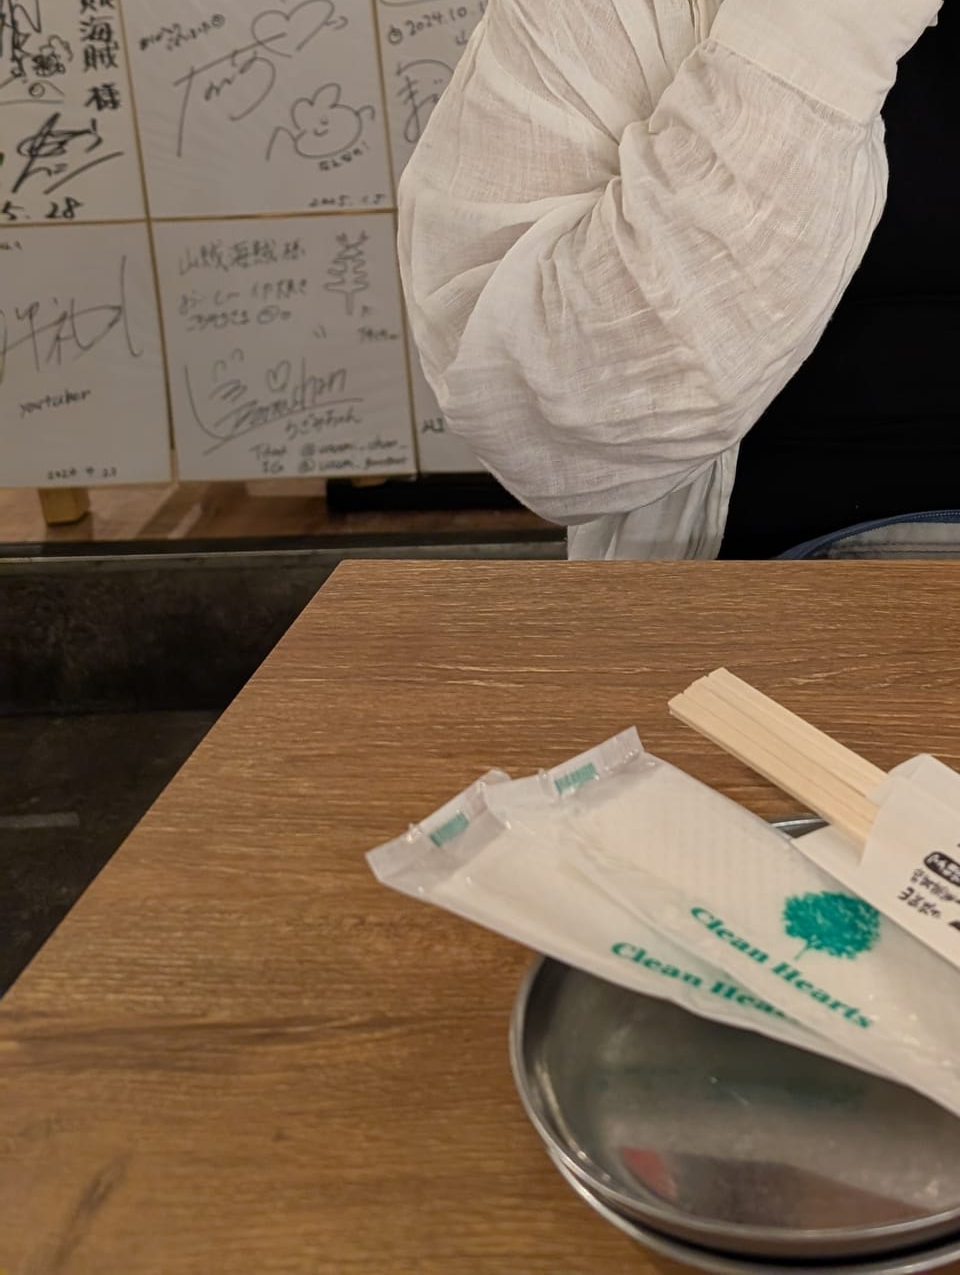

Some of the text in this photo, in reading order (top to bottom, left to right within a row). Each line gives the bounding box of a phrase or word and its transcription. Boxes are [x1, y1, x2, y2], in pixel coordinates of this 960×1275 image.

[611, 941, 703, 988] Clean
[690, 907, 870, 1029] Clean Hearts
